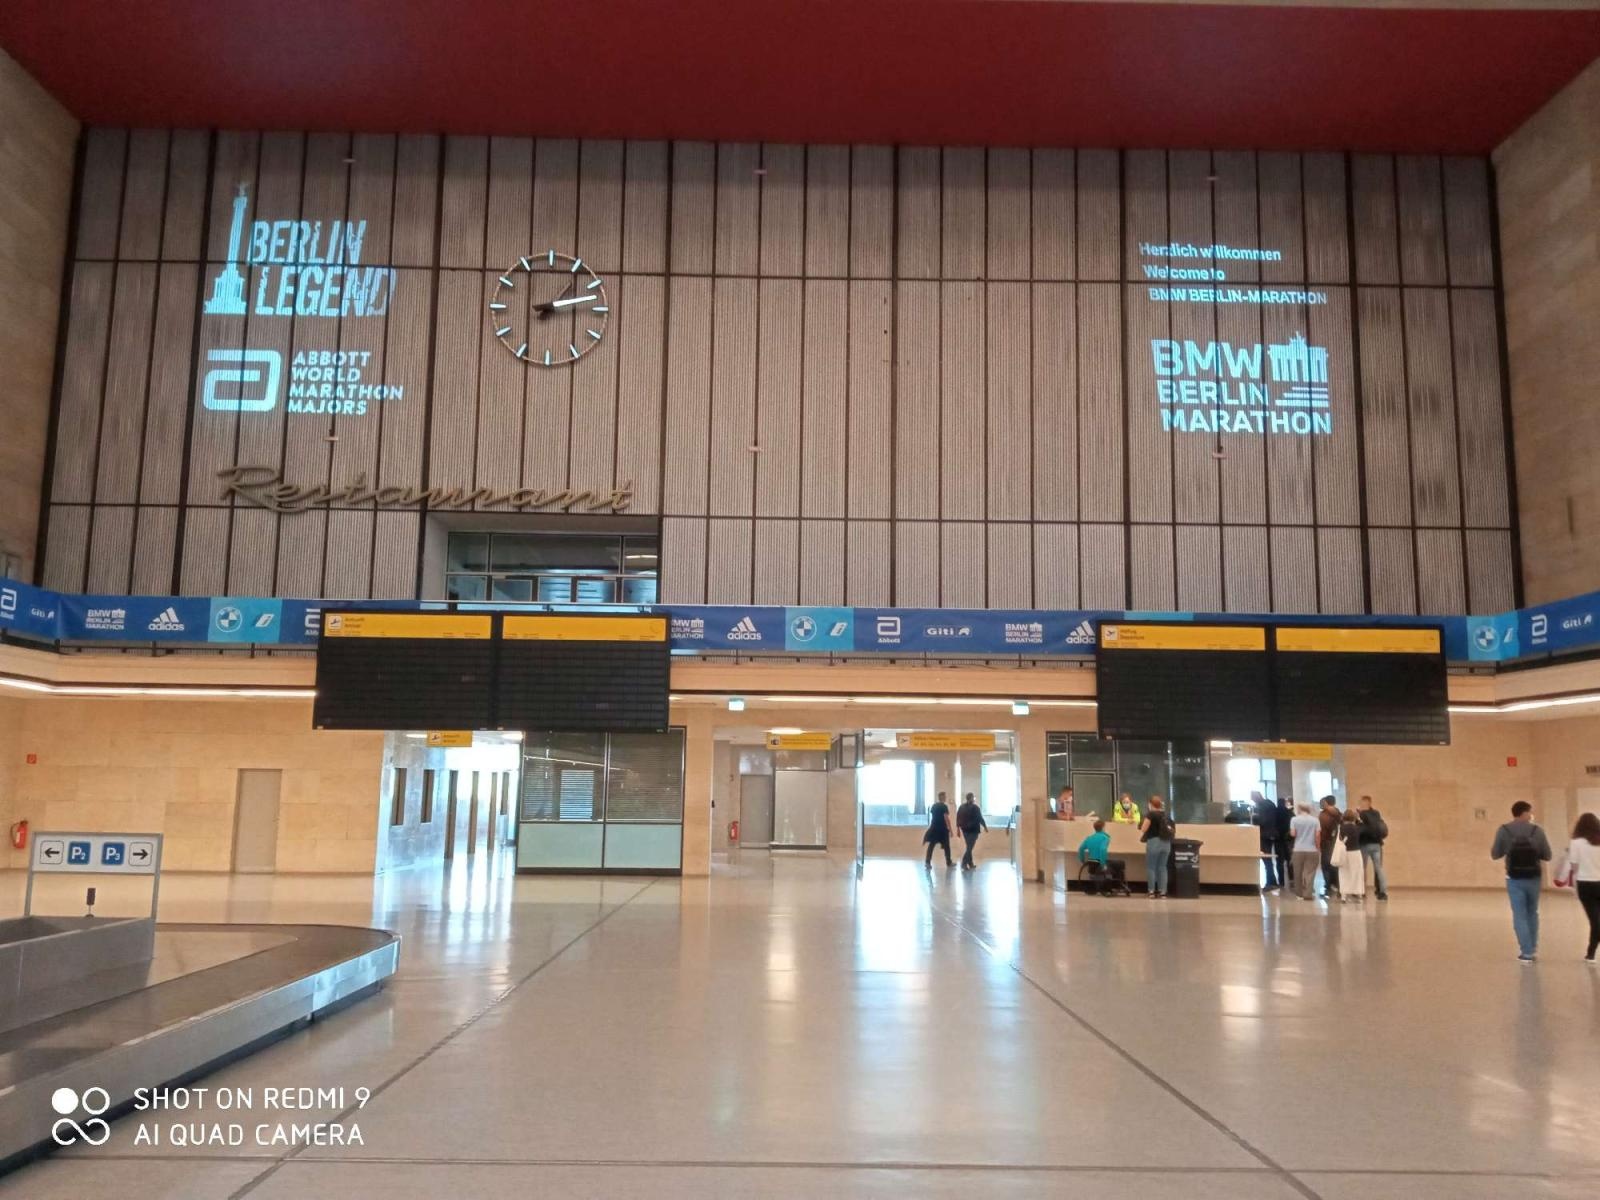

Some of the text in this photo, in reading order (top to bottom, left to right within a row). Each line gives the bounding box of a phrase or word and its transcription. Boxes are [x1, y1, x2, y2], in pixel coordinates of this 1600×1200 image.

[248, 220, 367, 265] BERLIN
[1139, 242, 1281, 261] Herzlich willkommen
[1143, 264, 1225, 281] Welcome to
[255, 265, 397, 317] LEGEND
[1149, 287, 1328, 304] BMW BERLIN-MARATHON
[292, 351, 371, 367] ABBOTT
[1151, 339, 1262, 379] BMW
[291, 367, 361, 382] WORLD
[289, 383, 404, 400] MARATHON
[1157, 379, 1269, 406] BERLIN
[288, 399, 368, 416] MAJORS
[1160, 408, 1332, 434] MARATHON
[216, 464, 634, 513] Restaurant
[87, 609, 111, 617] BMW
[148, 622, 185, 631] adidas
[671, 619, 690, 627] MW
[926, 627, 954, 636] Giti
[1005, 623, 1028, 631] BMW
[727, 629, 762, 641] adidas
[1065, 635, 1096, 645] adida
